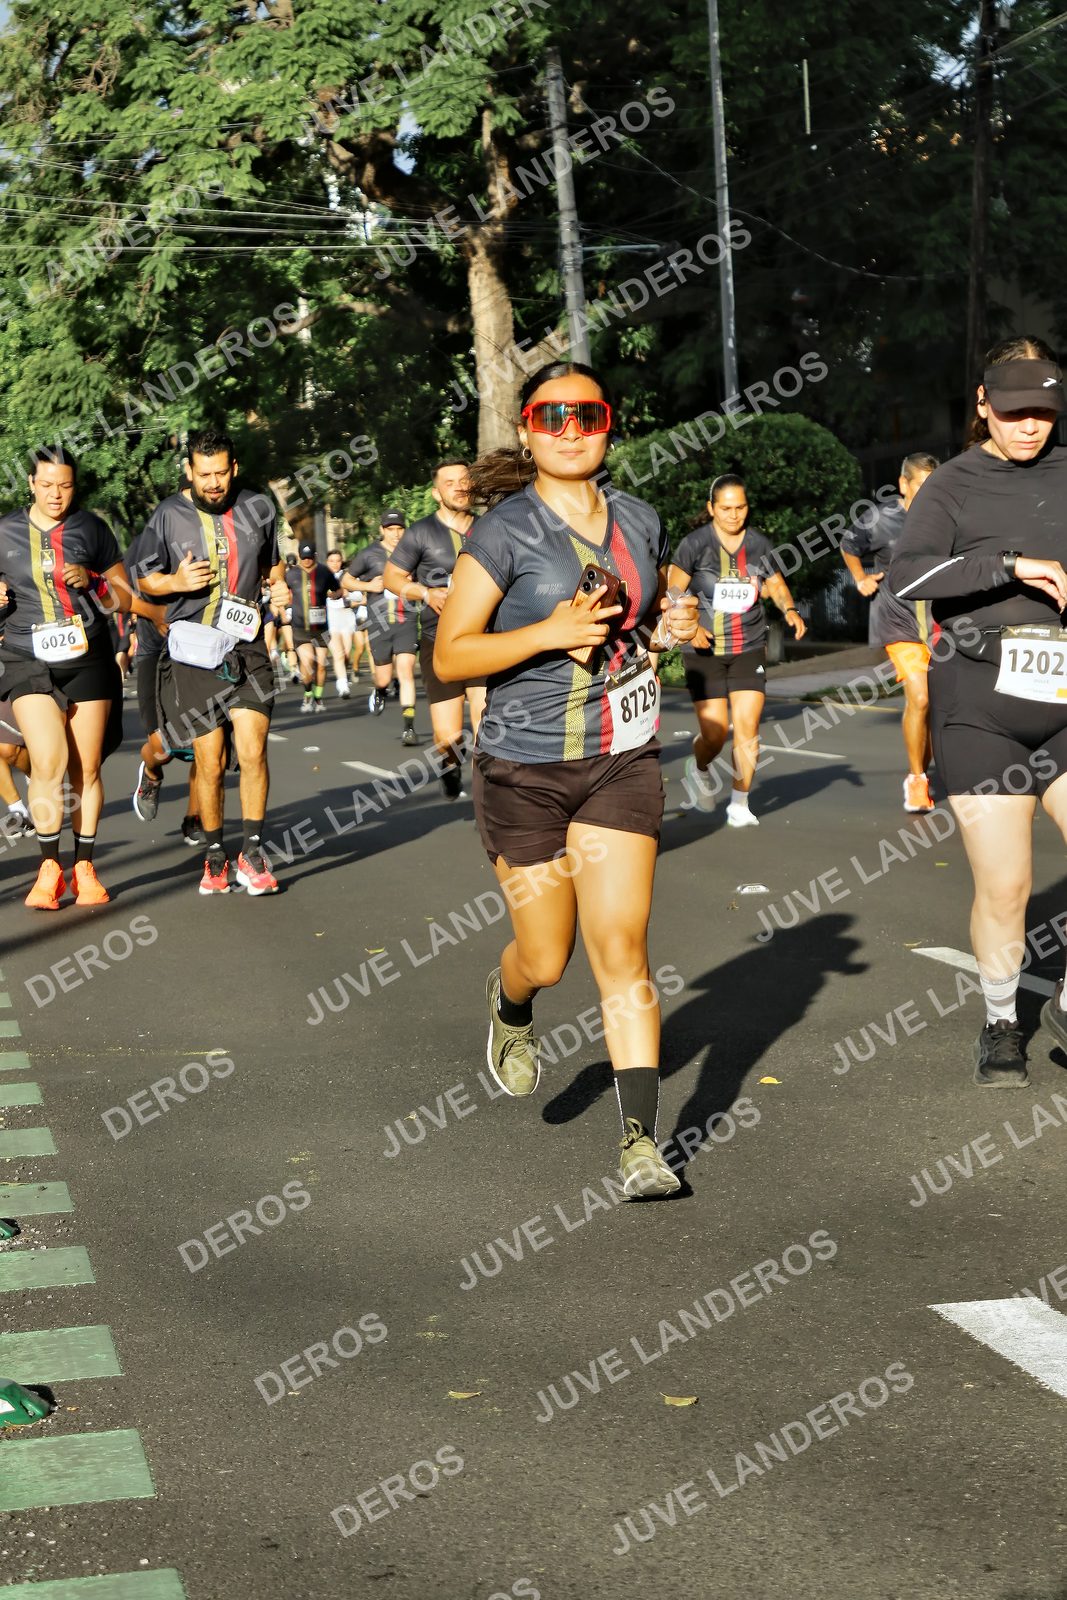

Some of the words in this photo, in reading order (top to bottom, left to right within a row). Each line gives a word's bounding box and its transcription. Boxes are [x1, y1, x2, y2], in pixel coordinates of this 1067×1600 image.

[721, 588, 749, 600] 9449
[226, 607, 254, 626] 6029
[41, 631, 76, 650] 6026
[1007, 648, 1067, 676] 1202
[620, 679, 657, 723] 8729
